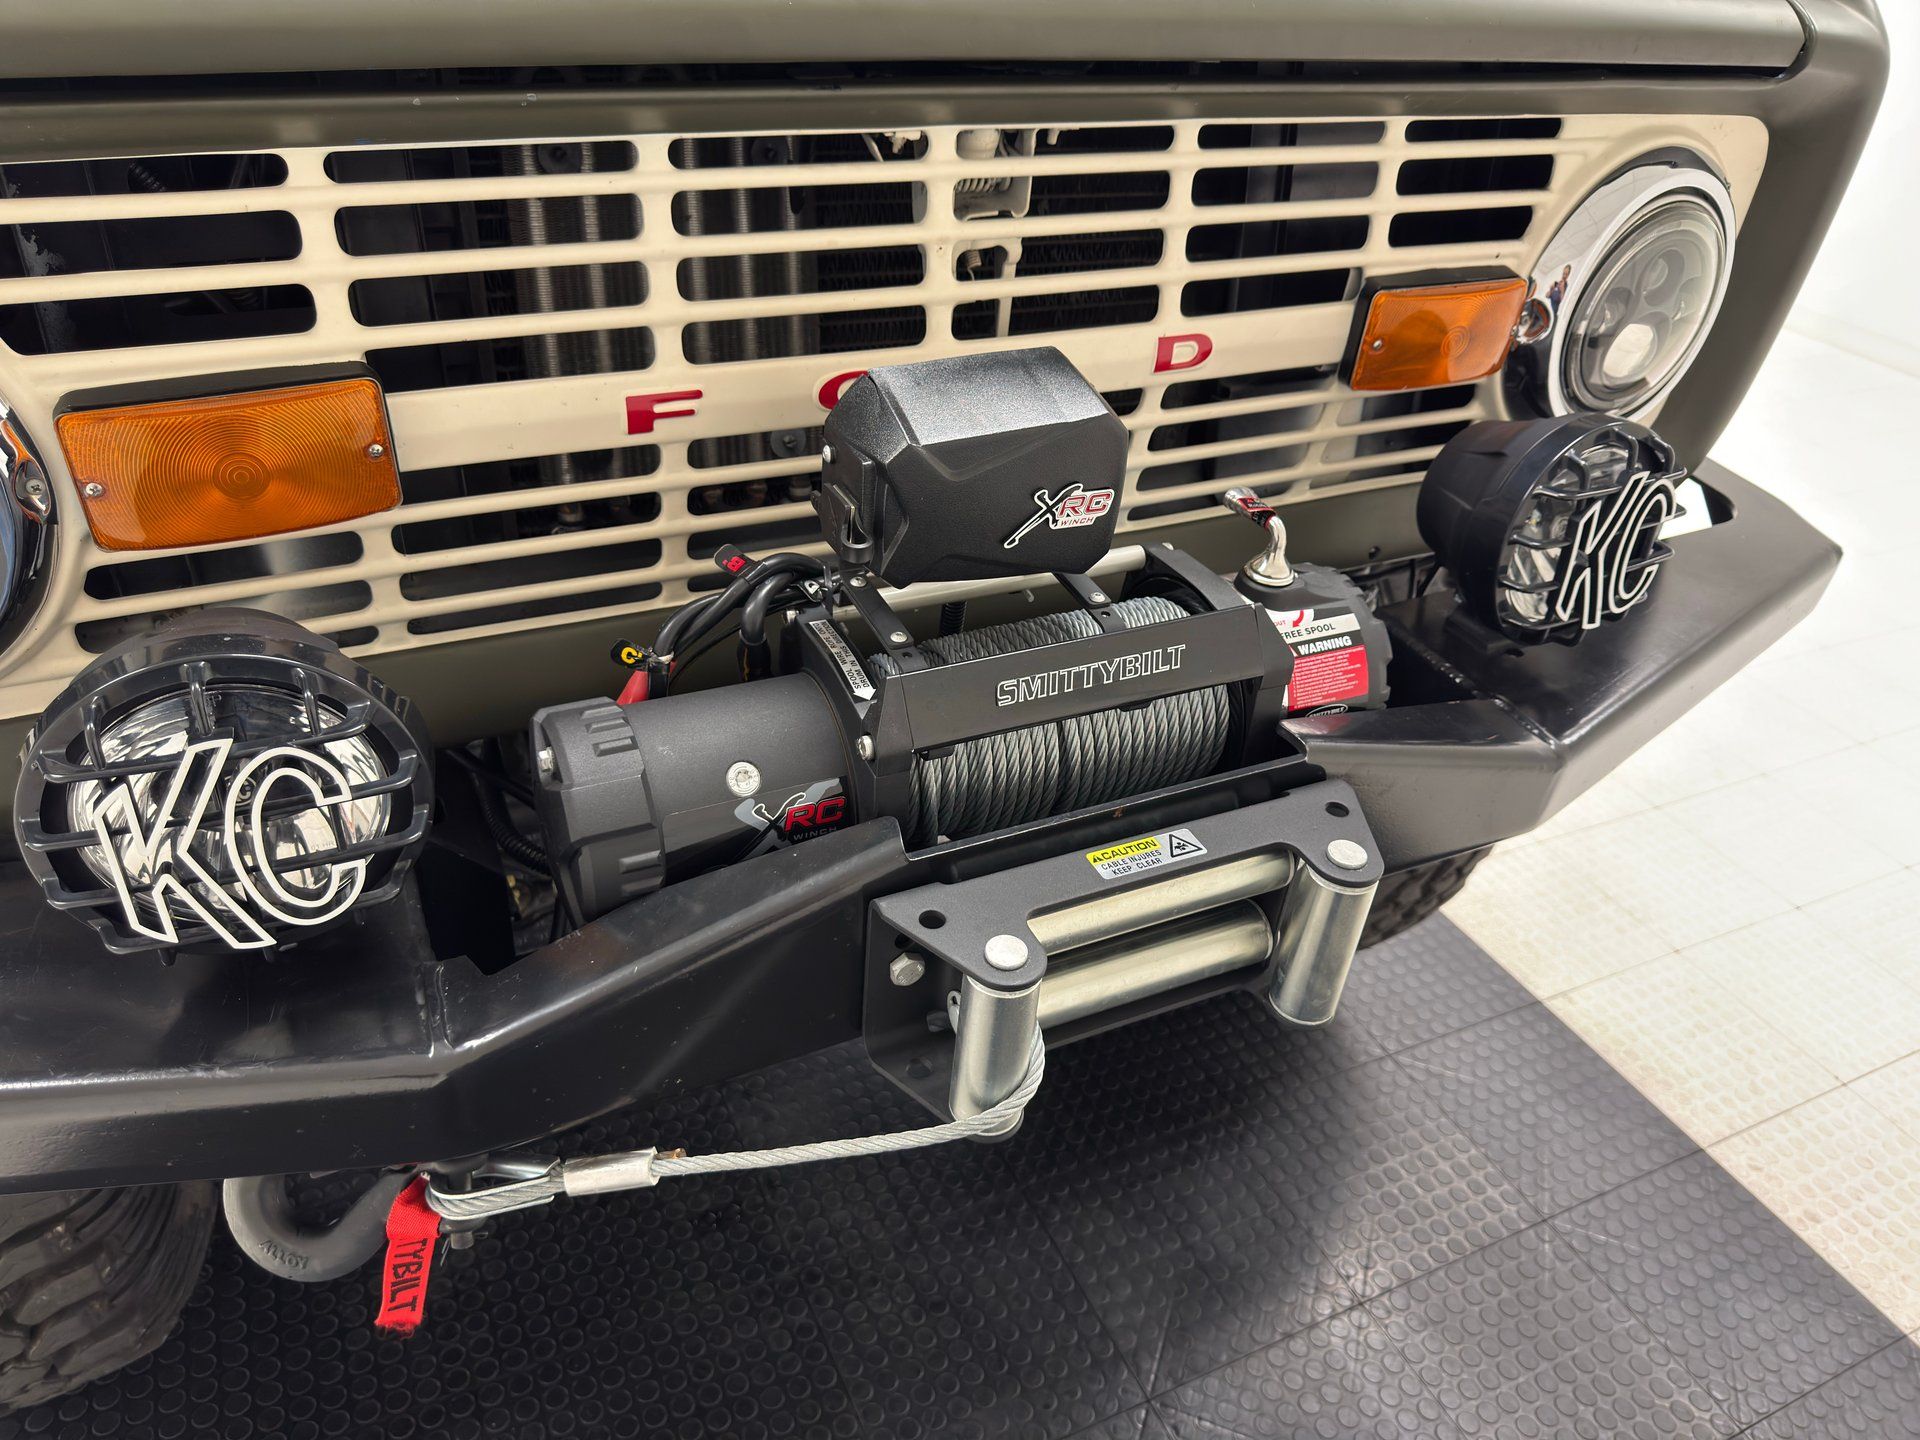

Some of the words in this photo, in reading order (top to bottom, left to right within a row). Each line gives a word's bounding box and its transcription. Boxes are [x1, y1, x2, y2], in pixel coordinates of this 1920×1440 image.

[1060, 516, 1094, 527] WINCH
[1555, 471, 1677, 629] KC
[1305, 623, 1336, 635] SPOOL
[823, 636, 838, 649] ROPE
[840, 645, 853, 658] THIS
[1297, 636, 1352, 655] WARNING
[834, 651, 849, 666] WIRE
[845, 668, 862, 689] SPOOL
[854, 669, 870, 688] DRUM
[996, 644, 1186, 707] SMITTYBILT
[793, 826, 838, 841] WINCH
[93, 738, 367, 949] KC
[1101, 839, 1158, 860] CAUTION
[1101, 858, 1128, 870] CABLE
[1128, 850, 1162, 863] INJURES
[1112, 865, 1132, 876] KEEP
[1136, 858, 1163, 869] CLEAR
